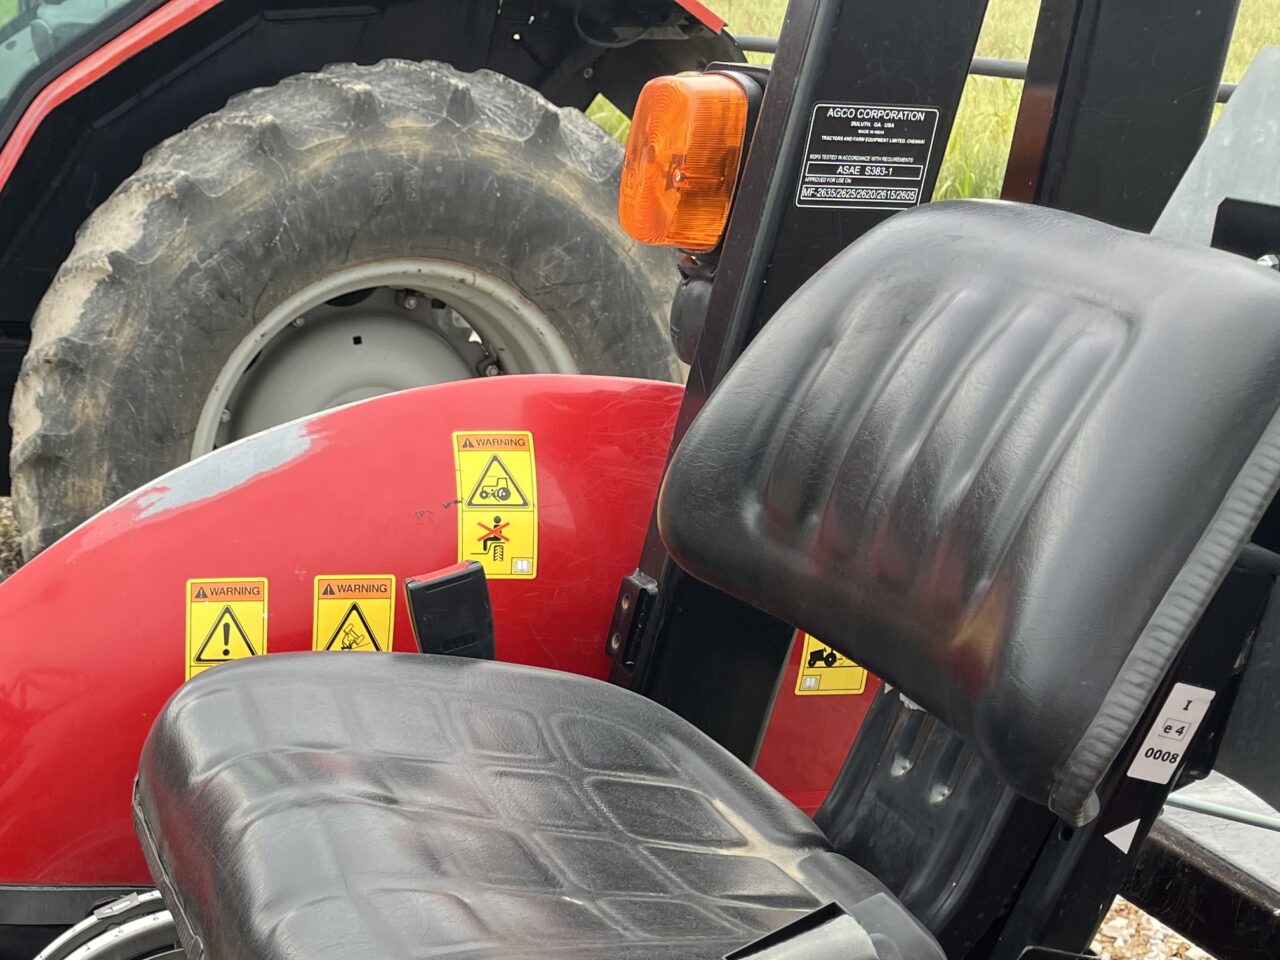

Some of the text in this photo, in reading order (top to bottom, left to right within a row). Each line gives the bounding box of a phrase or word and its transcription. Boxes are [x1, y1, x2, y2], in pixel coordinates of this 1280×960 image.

[827, 108, 926, 121] AGCO CORPORATION
[836, 165, 893, 176] ASAE S383-1
[802, 188, 916, 200] MF-2635/2625/2620/2615/2605
[475, 437, 526, 448] WARNING
[210, 586, 261, 597] WARNING
[337, 584, 388, 594] WARNING
[1144, 747, 1180, 764] 0008
